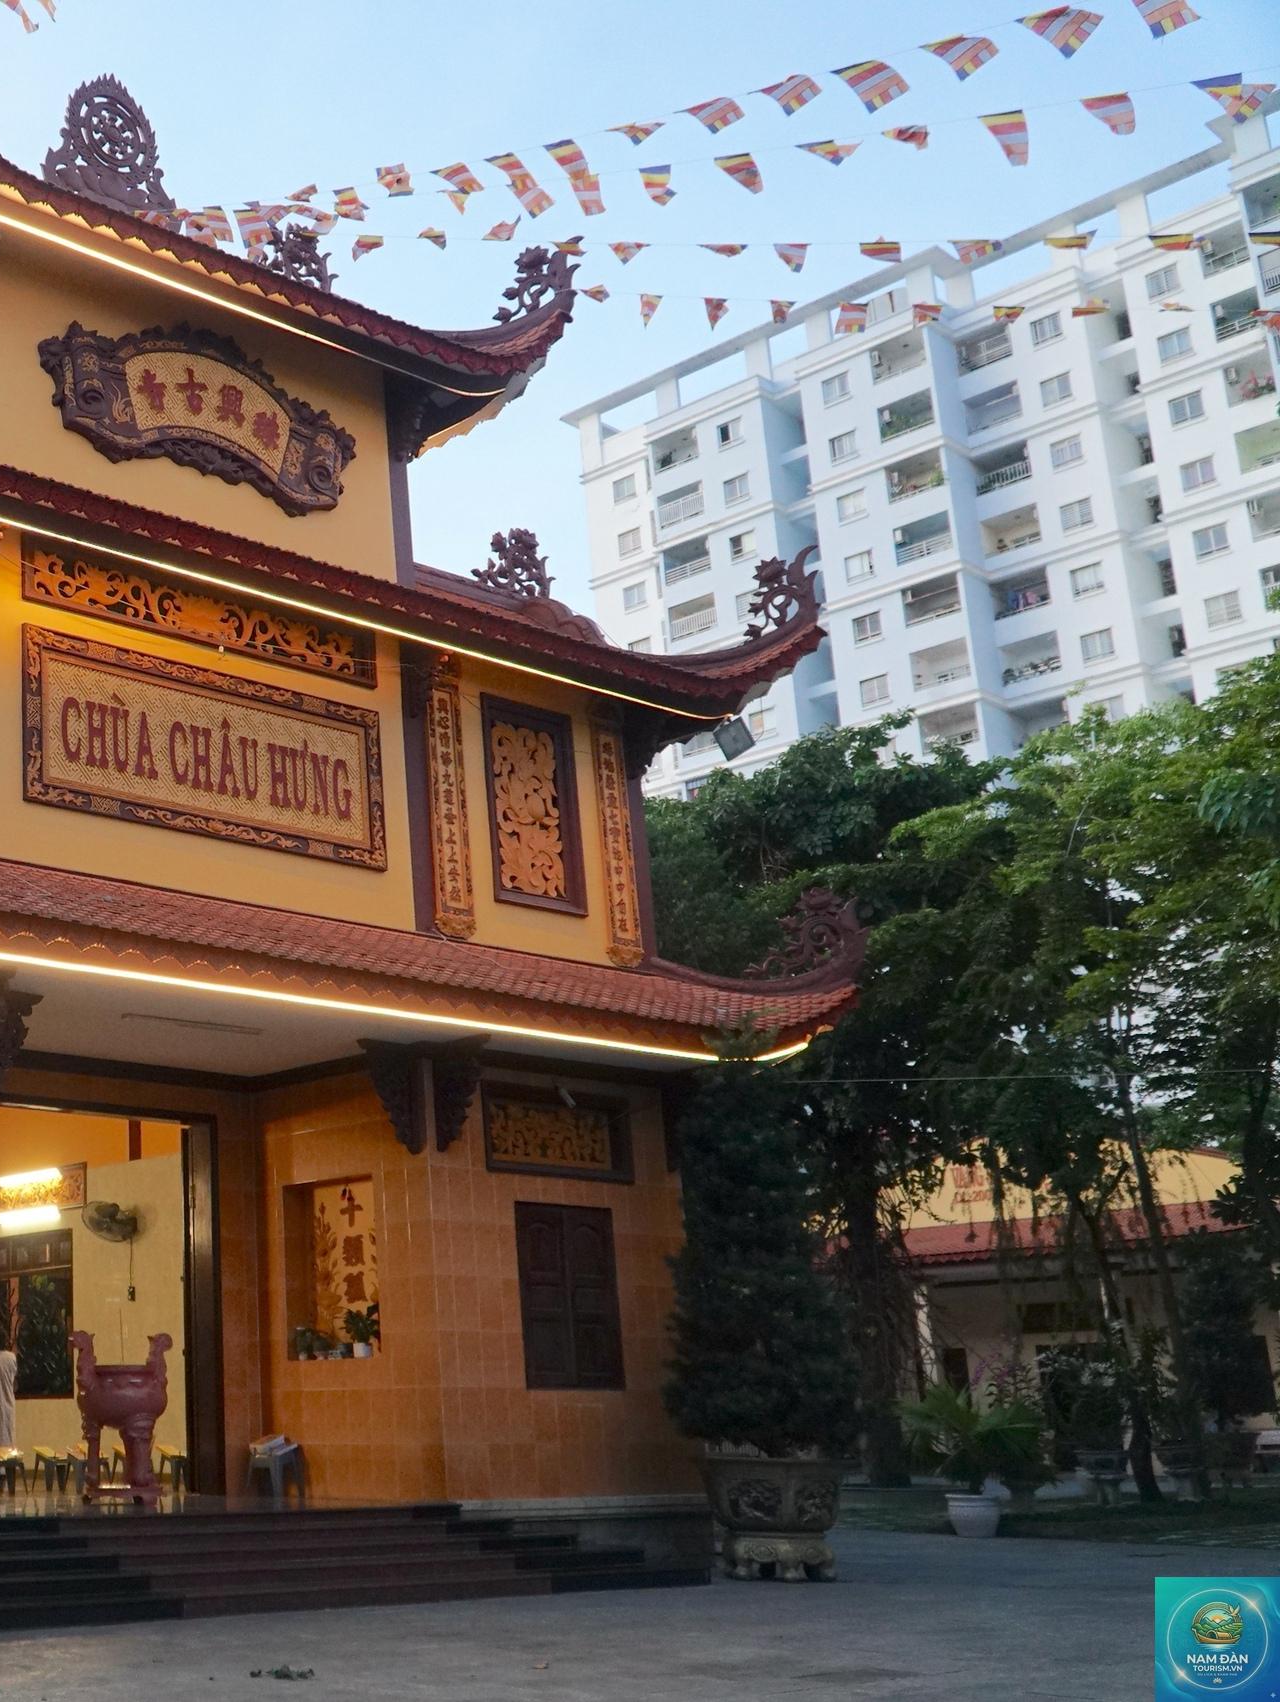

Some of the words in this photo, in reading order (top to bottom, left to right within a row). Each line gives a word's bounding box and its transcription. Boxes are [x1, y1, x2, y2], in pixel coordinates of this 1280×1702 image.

[61, 692, 159, 780] CHÙA
[170, 717, 258, 800] CHÂU
[267, 739, 352, 821] HƯNG
